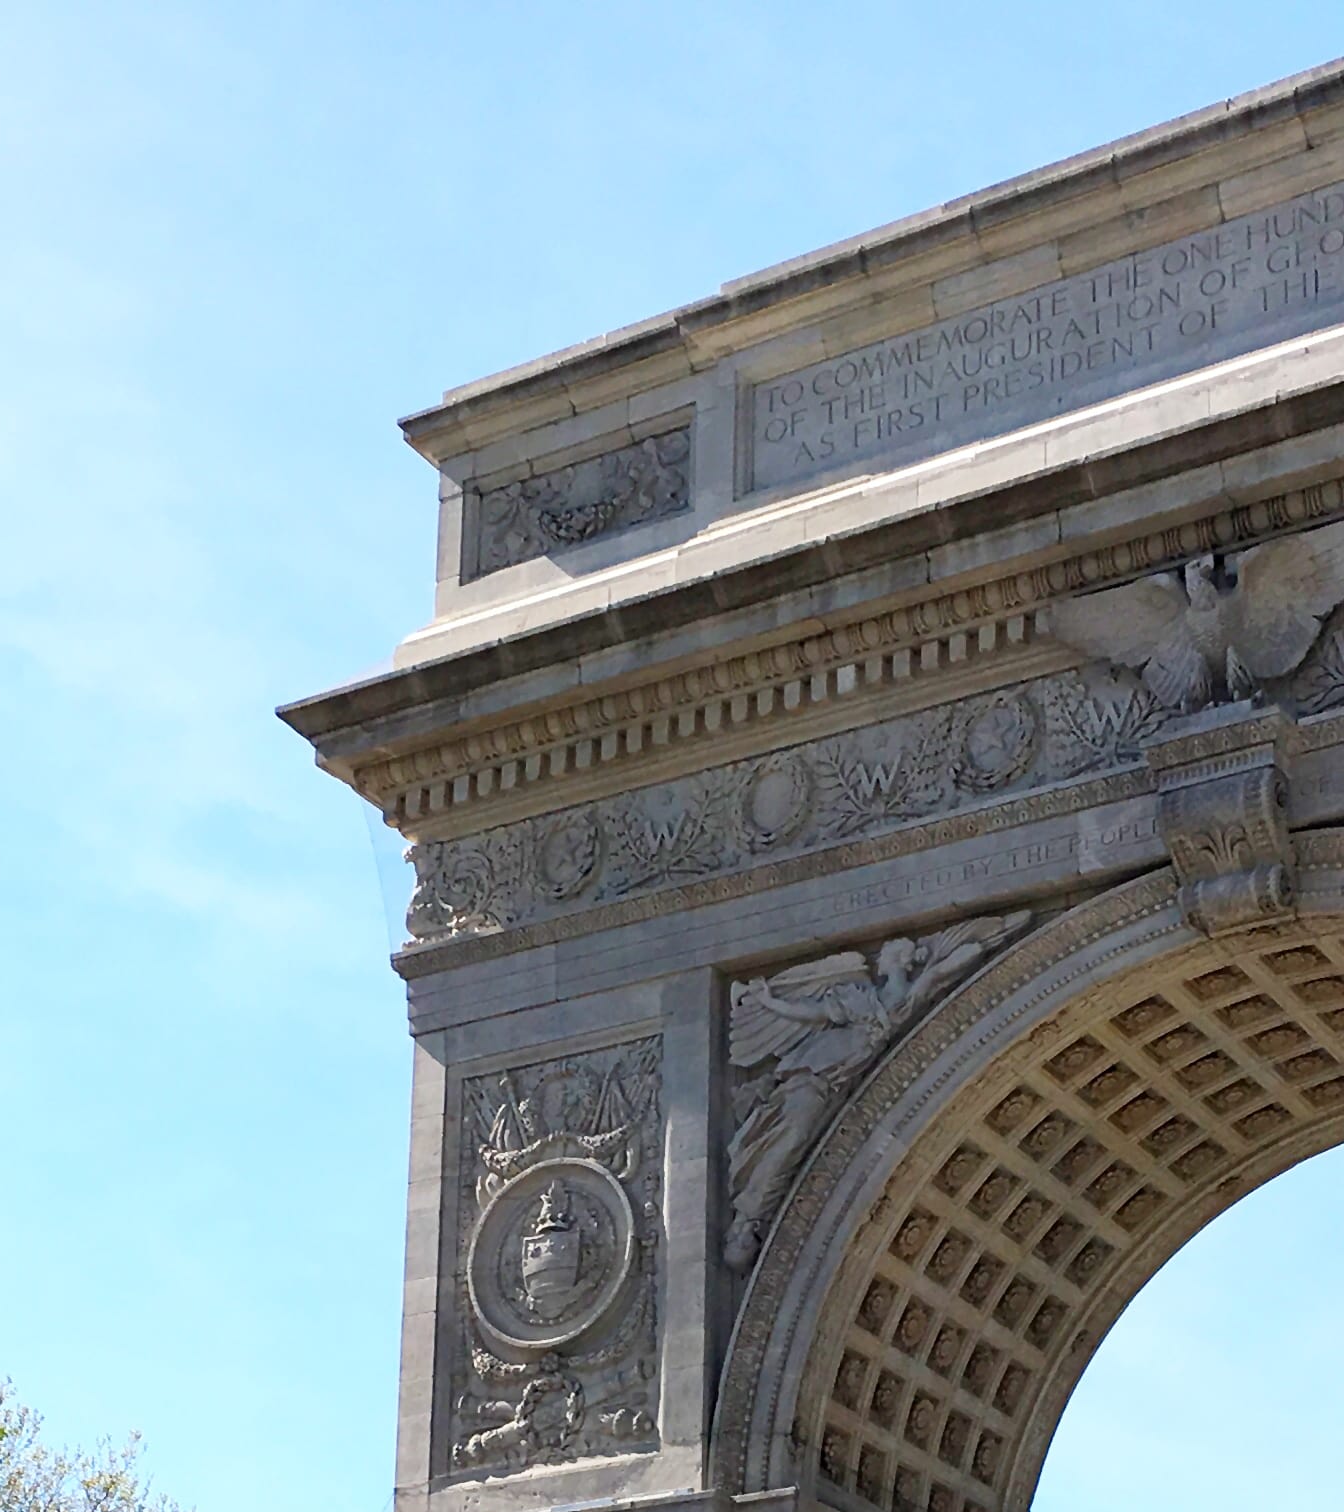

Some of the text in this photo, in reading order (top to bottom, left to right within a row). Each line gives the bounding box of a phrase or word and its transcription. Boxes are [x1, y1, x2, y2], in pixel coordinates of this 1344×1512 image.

[764, 407, 807, 443] OF
[820, 383, 887, 425] THE
[903, 281, 1181, 399] INAUGURATION
[1199, 256, 1252, 297] OF
[765, 380, 804, 413] TO
[812, 287, 1069, 396] COMMEMORATE
[1082, 256, 1153, 303] THE
[1162, 234, 1235, 276] ONE
[793, 431, 834, 466] AS
[854, 393, 948, 448] FIRST
[963, 323, 1160, 412] PRESIDENT
[1179, 300, 1228, 337] OF
[1255, 267, 1337, 312] THE
[856, 752, 903, 799] W
[962, 858, 994, 881] BY
[1010, 844, 1054, 868] THE
